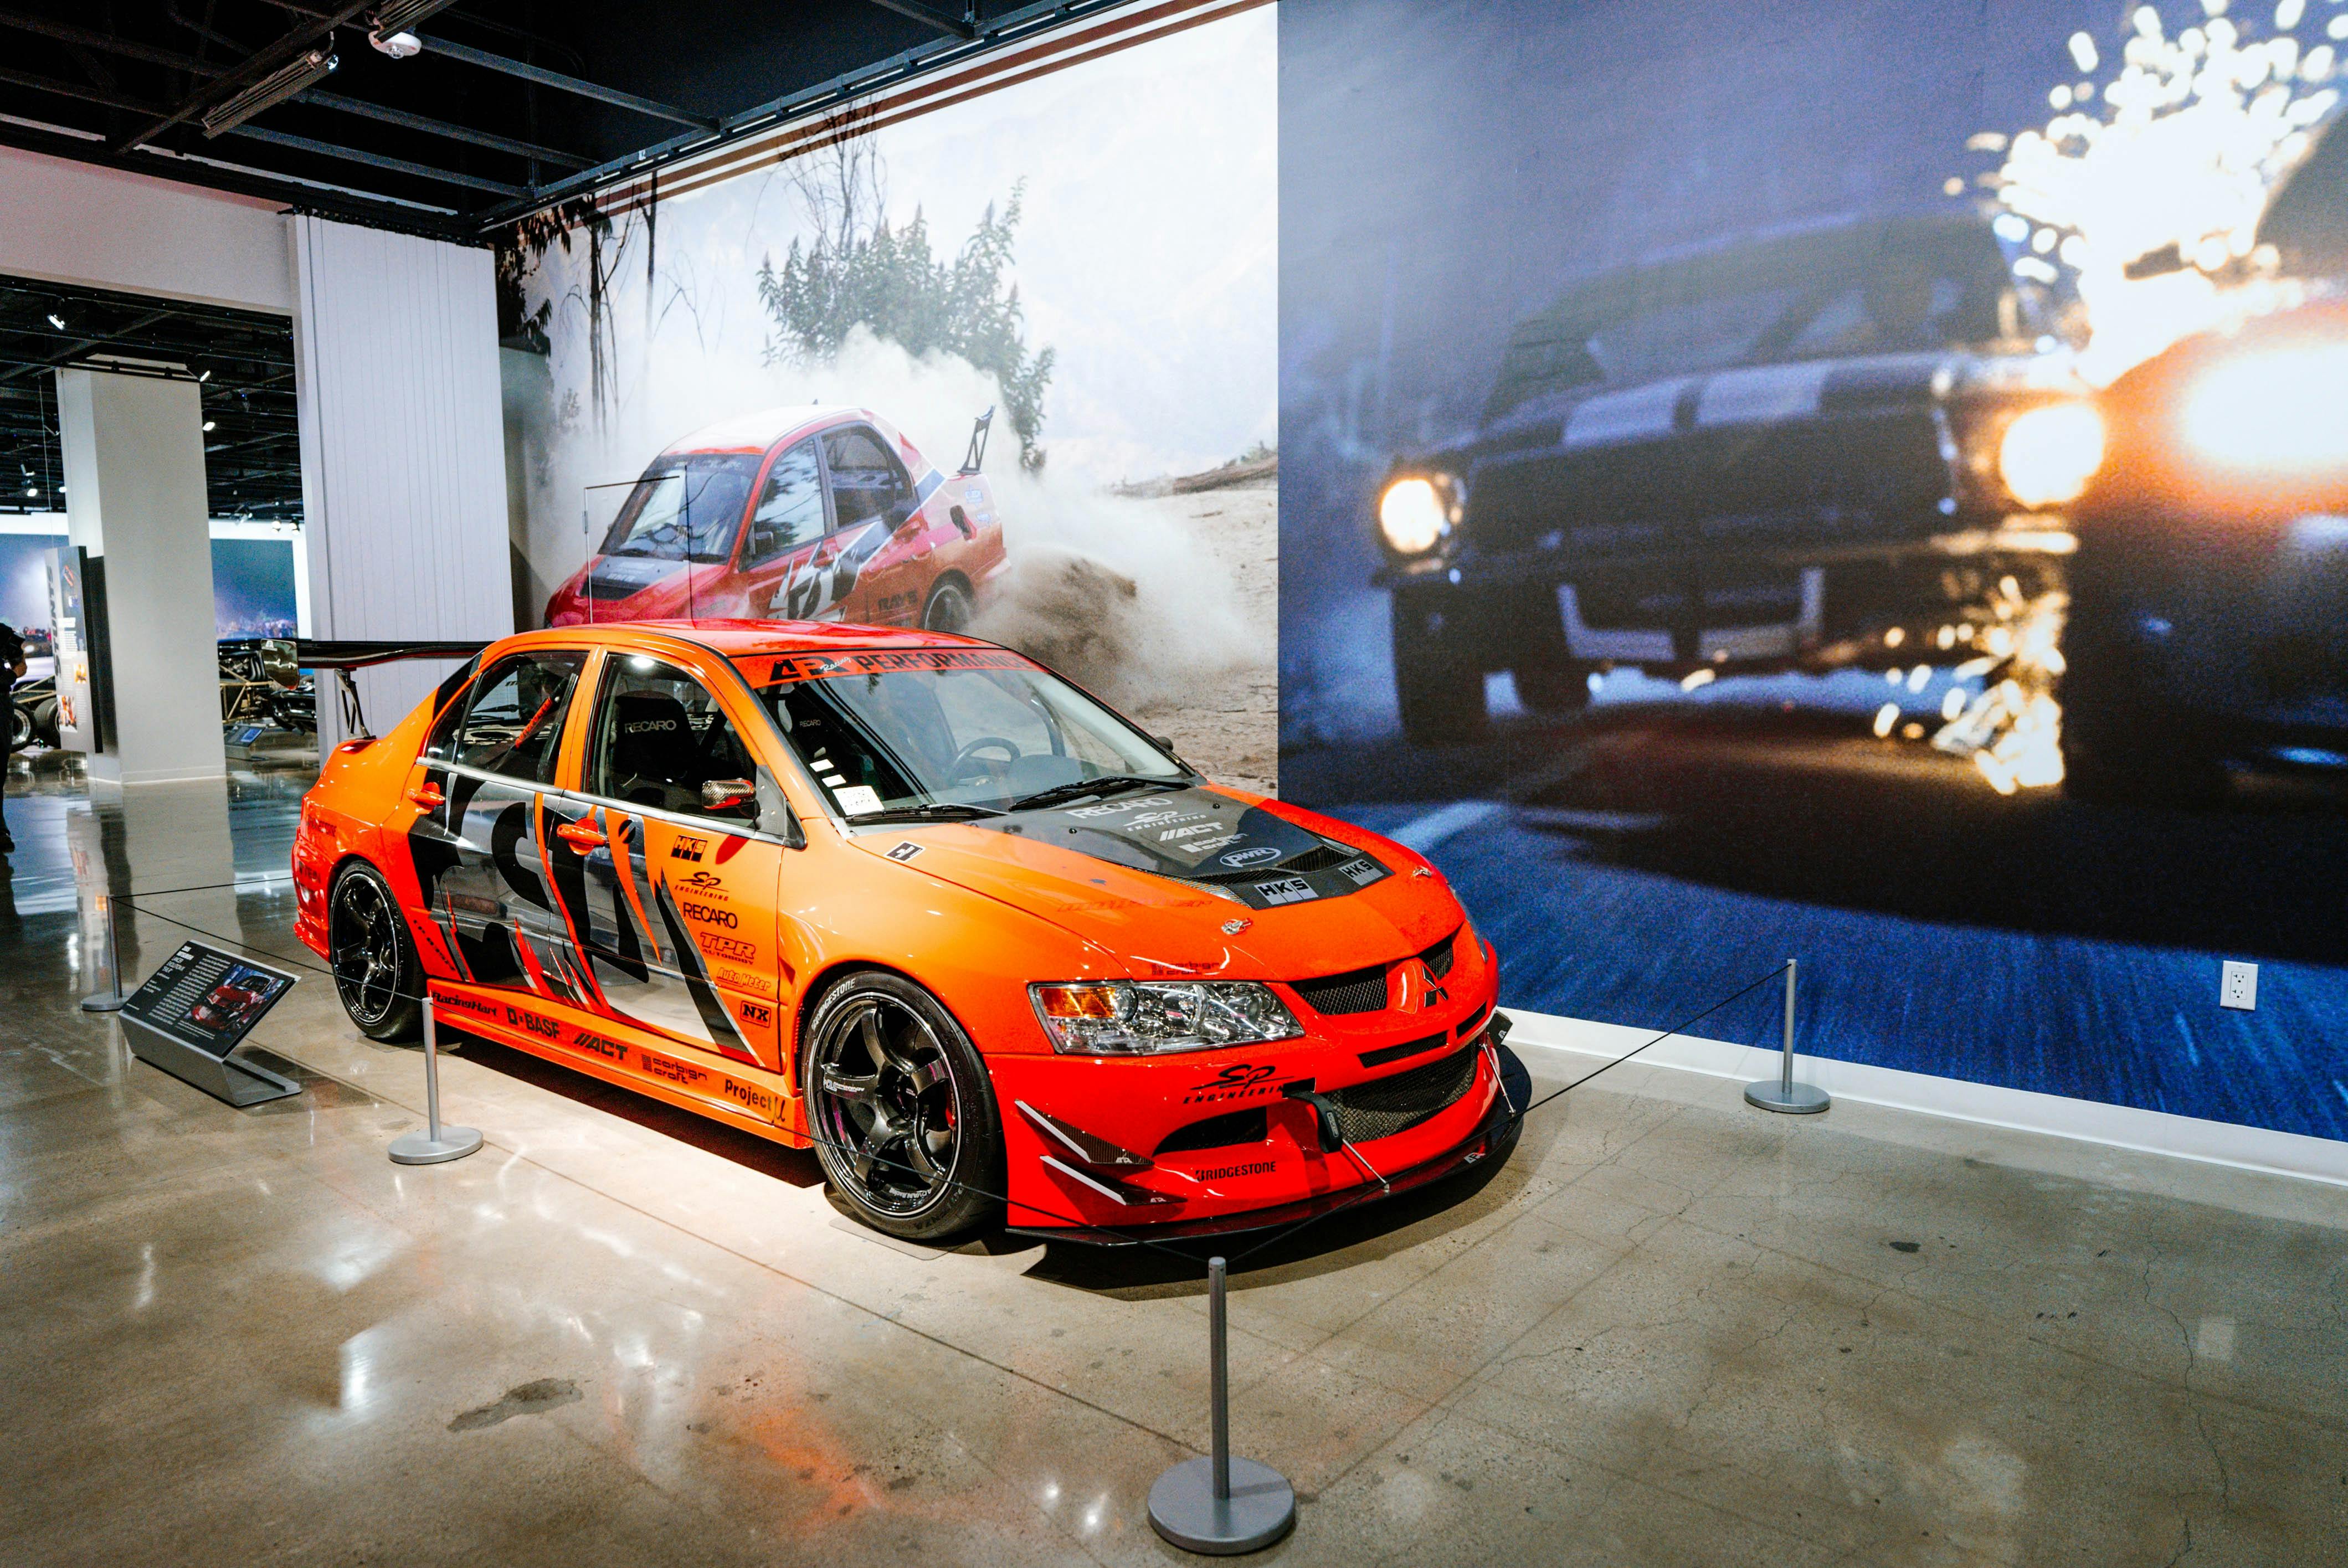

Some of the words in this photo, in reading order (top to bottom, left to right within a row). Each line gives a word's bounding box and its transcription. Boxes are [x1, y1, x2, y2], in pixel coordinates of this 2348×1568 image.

[47, 565, 61, 677] STUNTS
[852, 652, 1035, 671] PERFORMANCE
[624, 719, 677, 734] RECARO
[1065, 798, 1173, 819] RECARO
[1127, 815, 1207, 832] ENGINEERING
[674, 836, 706, 854] HKS
[1341, 861, 1374, 878] HKS
[674, 885, 729, 902] ENGINEERING
[1257, 880, 1309, 896] HKS
[682, 902, 738, 929] RECARO
[700, 932, 756, 959] TPR
[702, 948, 754, 965] AUTOBODY
[743, 1004, 769, 1022] NX
[1183, 1084, 1284, 1104] ENGINEERIN
[1195, 1161, 1276, 1182] BRIDGESTONE
